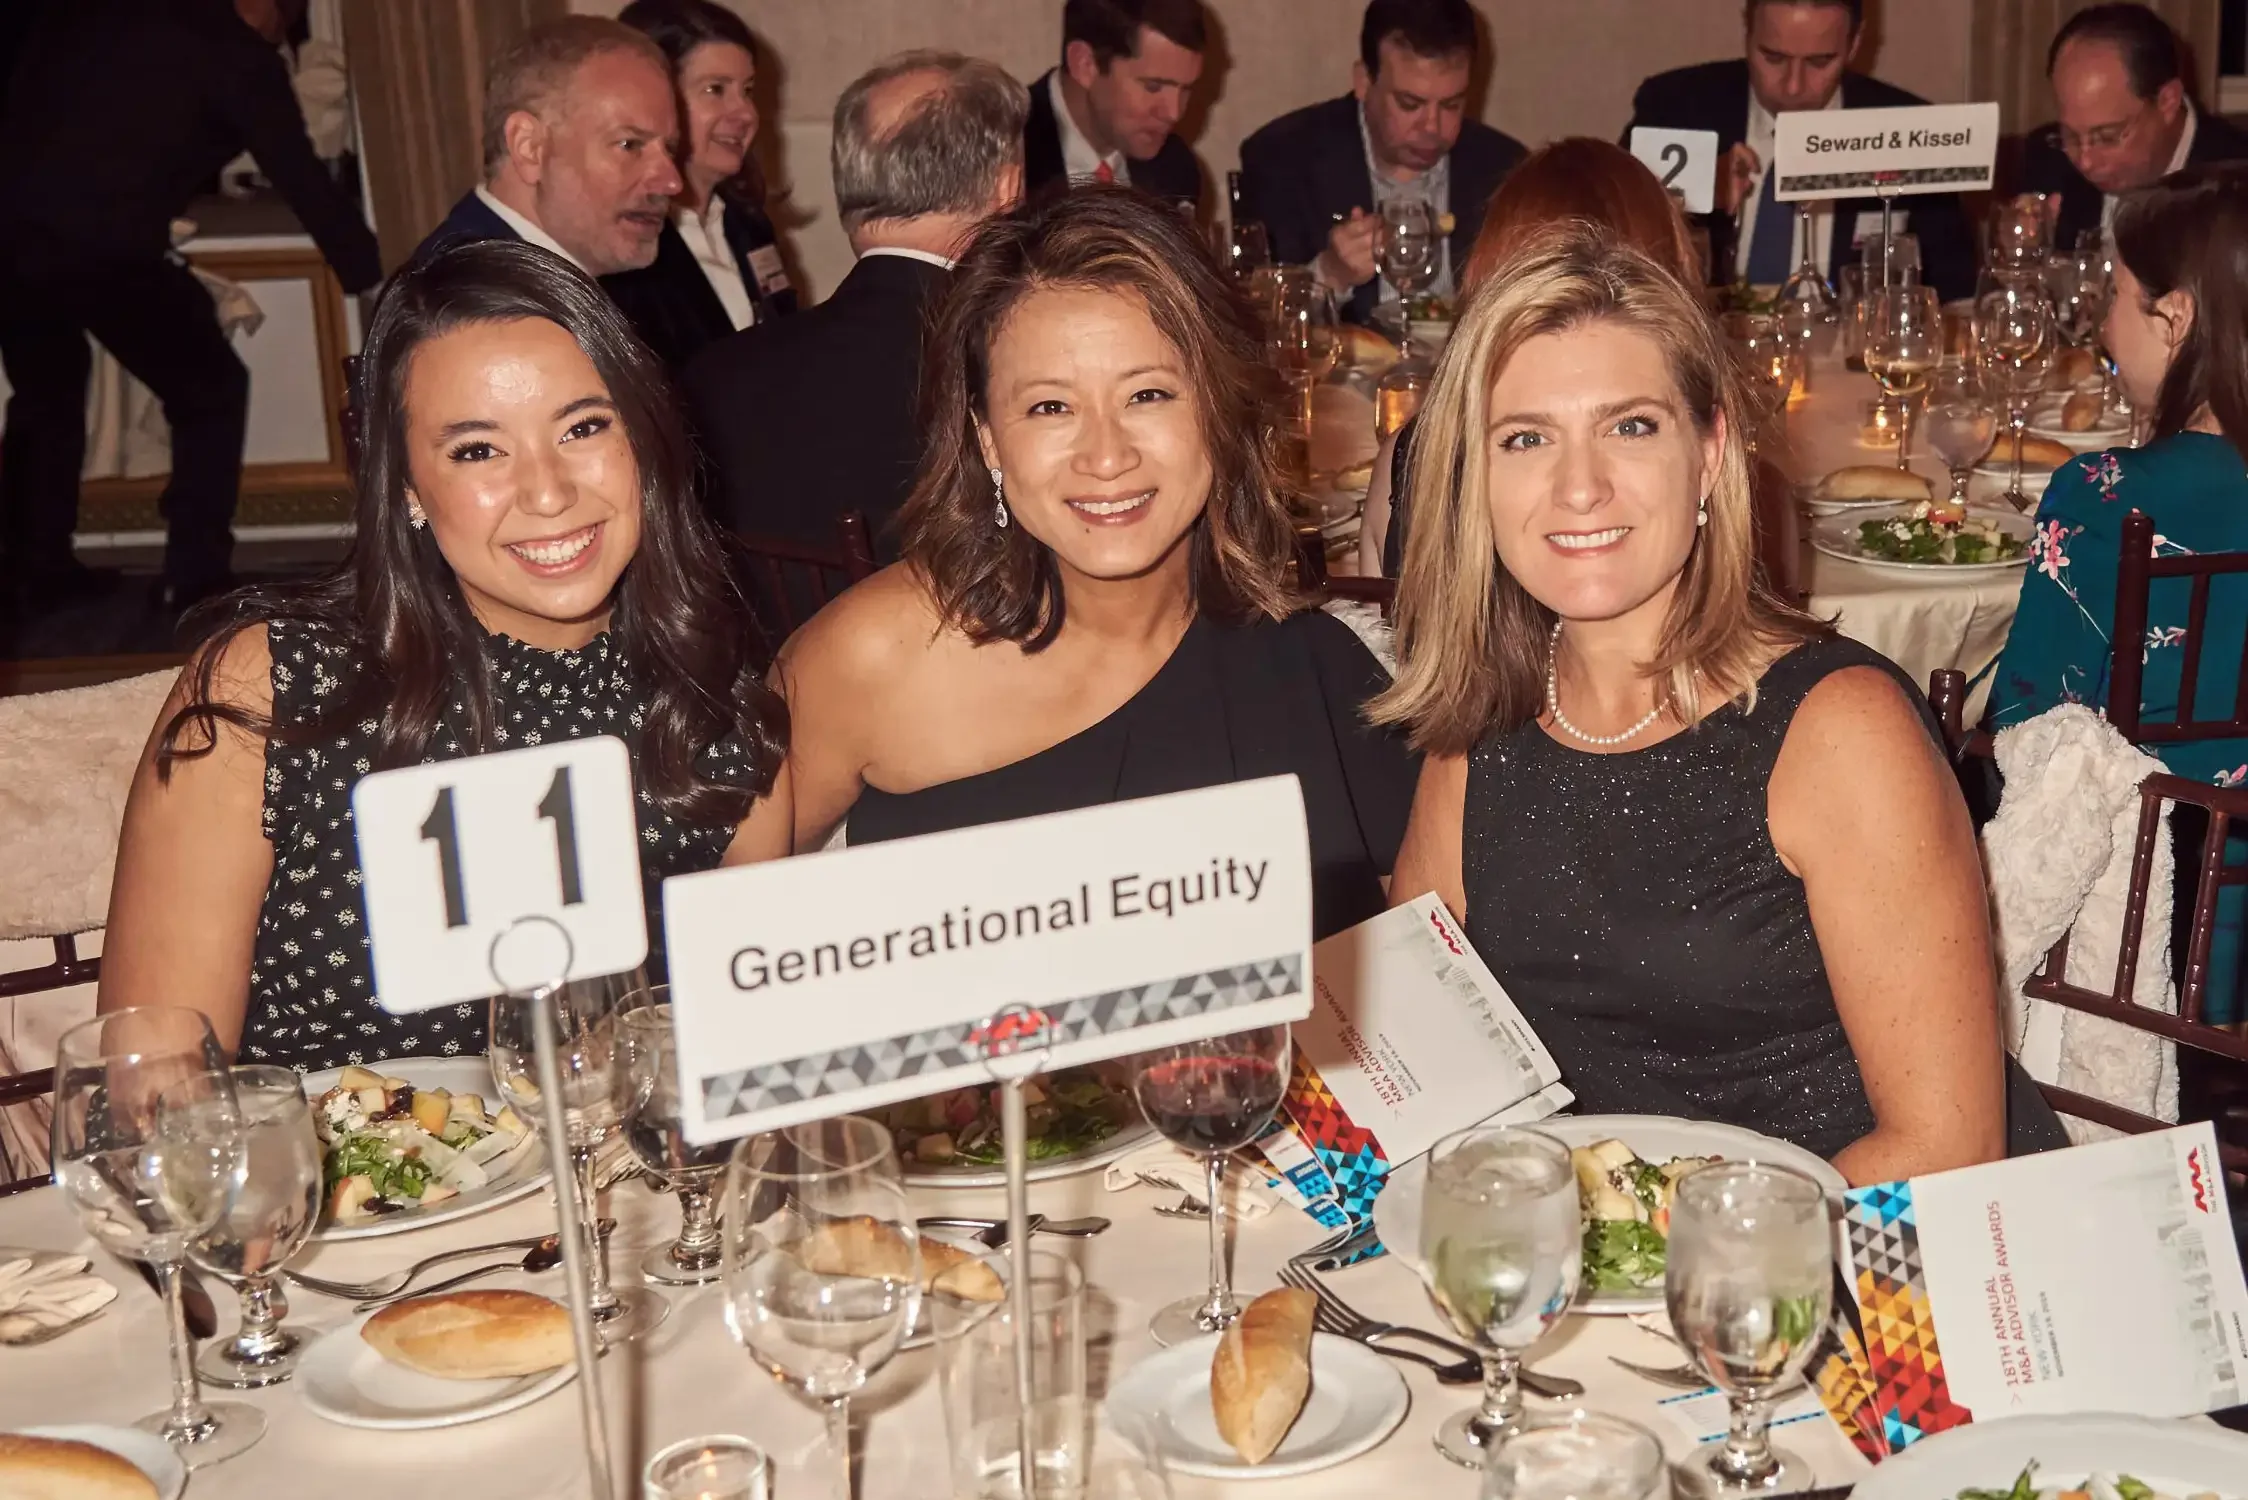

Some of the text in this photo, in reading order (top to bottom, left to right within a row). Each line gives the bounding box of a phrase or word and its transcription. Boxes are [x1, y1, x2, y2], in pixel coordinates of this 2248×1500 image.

[1660, 143, 1688, 197] 2
[1805, 128, 1971, 154] Seward & Kissel
[729, 857, 1268, 991] Generational Equity
[1337, 1028, 1396, 1107] 18TH ANNUAL
[1346, 1024, 1385, 1073] ADVISOR
[1376, 1048, 1415, 1097] NEW YORK
[1382, 1074, 1405, 1103] M&A
[1987, 1199, 2036, 1384] M&A ADVISOR AWARDS
[1984, 1275, 2020, 1387] 18TH ANNUAL
[2027, 1309, 2051, 1381] NEW YORK
